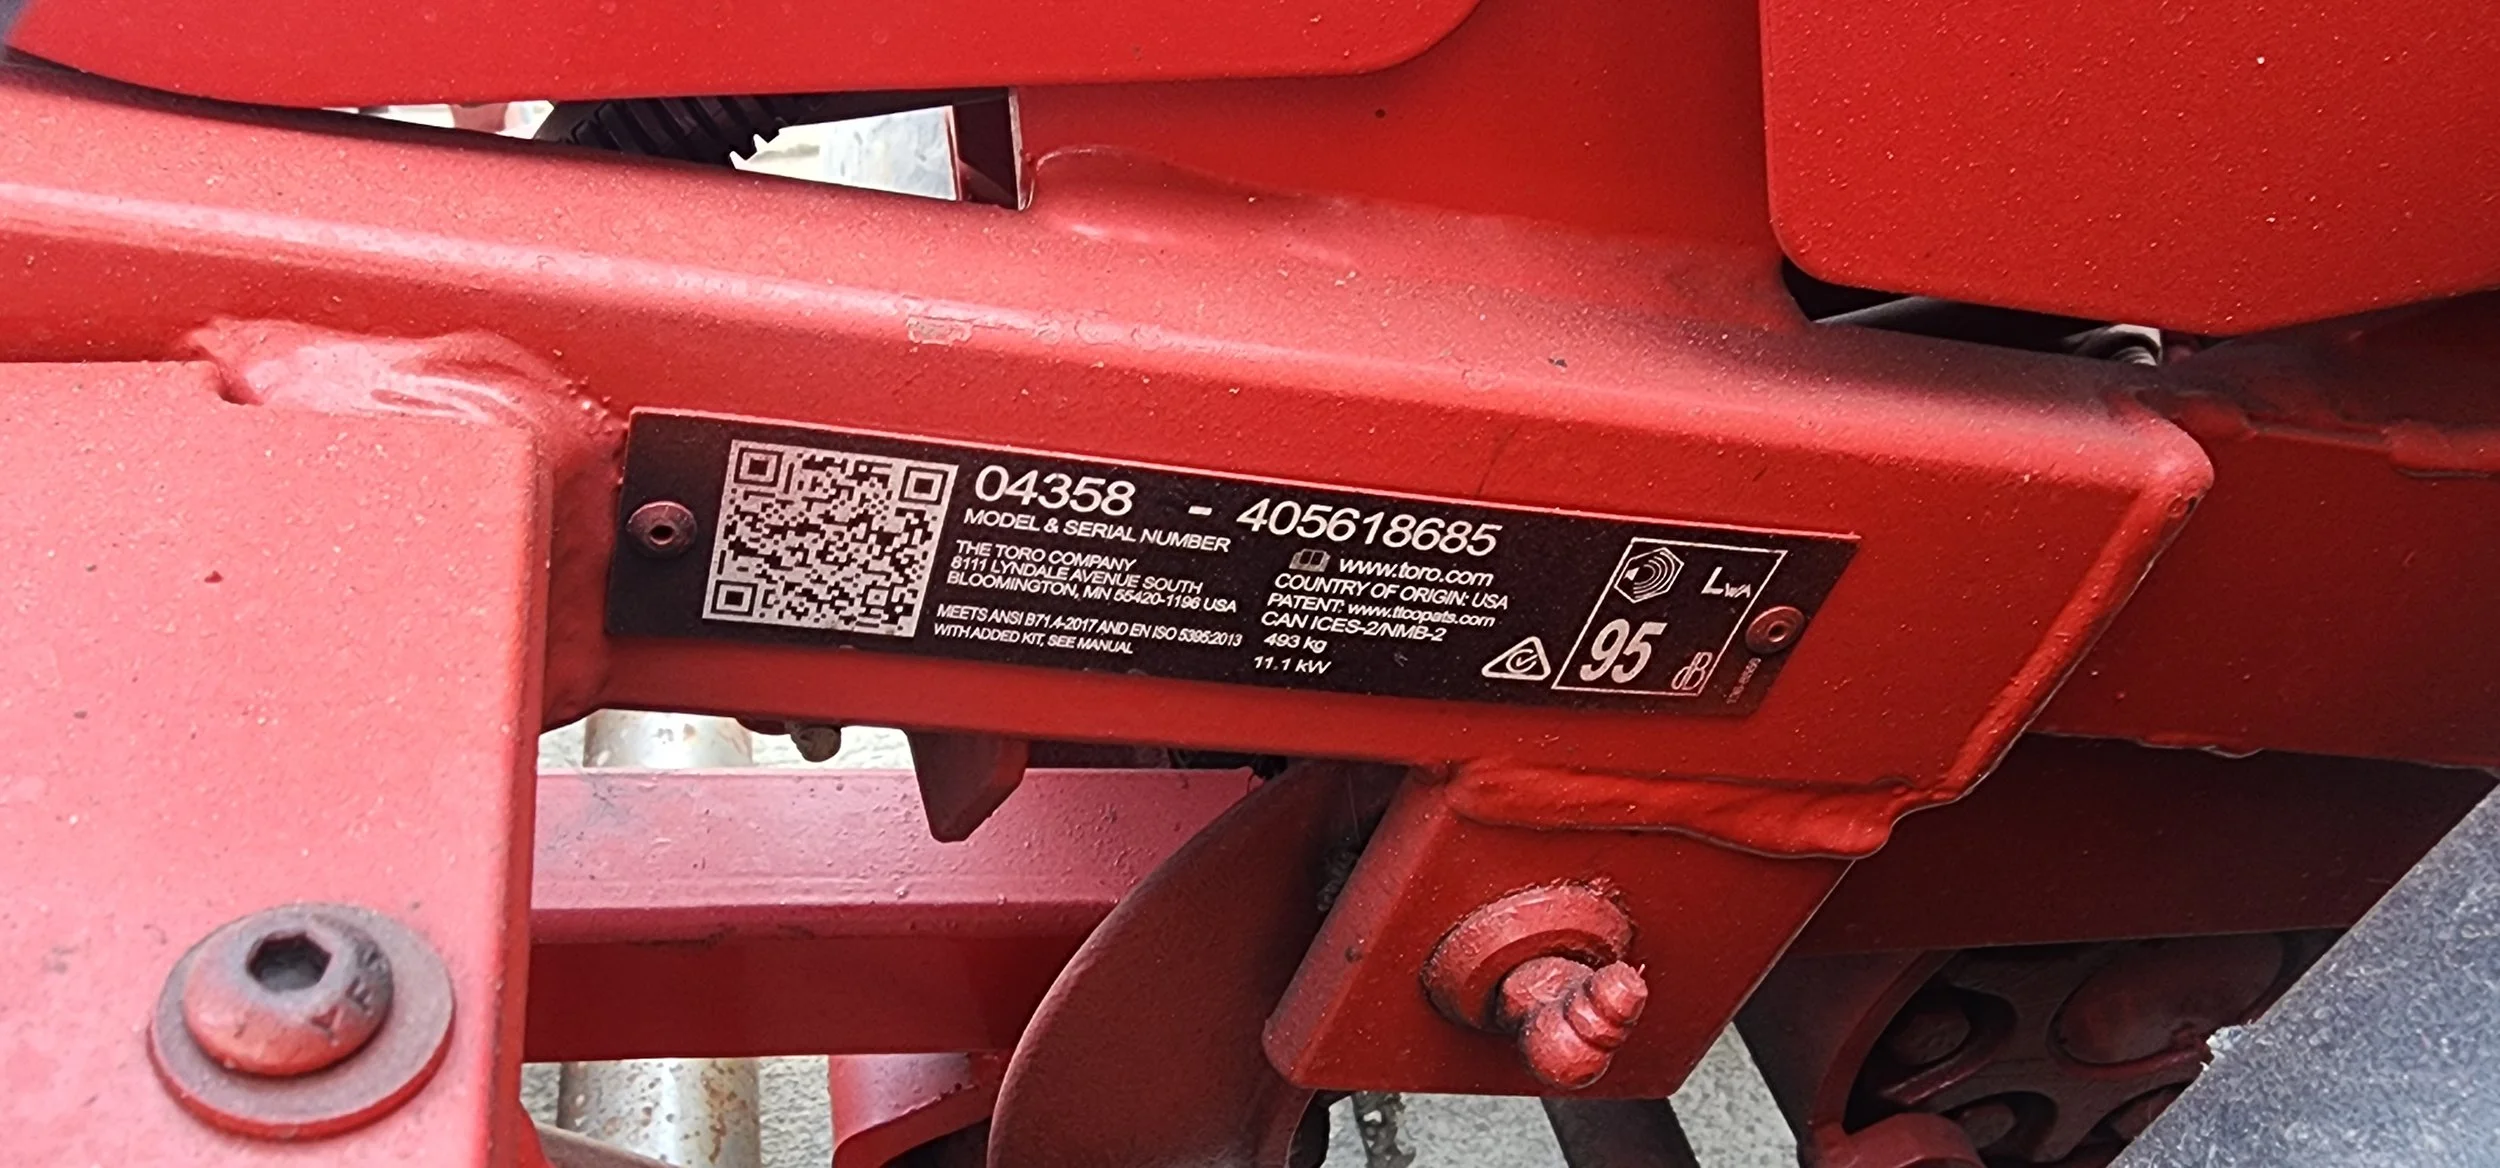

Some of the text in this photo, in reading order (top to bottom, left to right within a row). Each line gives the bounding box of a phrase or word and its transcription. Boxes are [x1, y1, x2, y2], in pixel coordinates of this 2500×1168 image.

[975, 465, 1503, 557] 04358 - 405618685
[964, 508, 1231, 552] MODEL & SERIAL NUMBER
[956, 539, 1137, 572] THE TORO COMPANY
[1339, 558, 1494, 587] www.toro.com
[946, 570, 1237, 613] BLOOMINGTON, MN 55420-1196 USA
[950, 555, 1204, 594] 8111 LYNDALE AVENUE SOUTH
[1274, 573, 1508, 610] COUNTRY OF ORIGIN: USA
[1267, 593, 1344, 614] PATENT:
[934, 622, 1133, 654] WITH ADDED KIT, SEE MANUAL
[936, 604, 989, 622] MEETS
[988, 608, 1024, 625] ANSI
[1096, 620, 1129, 636] AND
[1129, 622, 1151, 638] EN
[1151, 625, 1178, 641] ISO
[1261, 611, 1447, 641] CAN ICES-2/NMB-2
[1263, 633, 1328, 654] 493 kg
[1579, 618, 1668, 684] 95
[1671, 651, 1713, 691] dB
[1254, 656, 1332, 674] 11.1 kW
